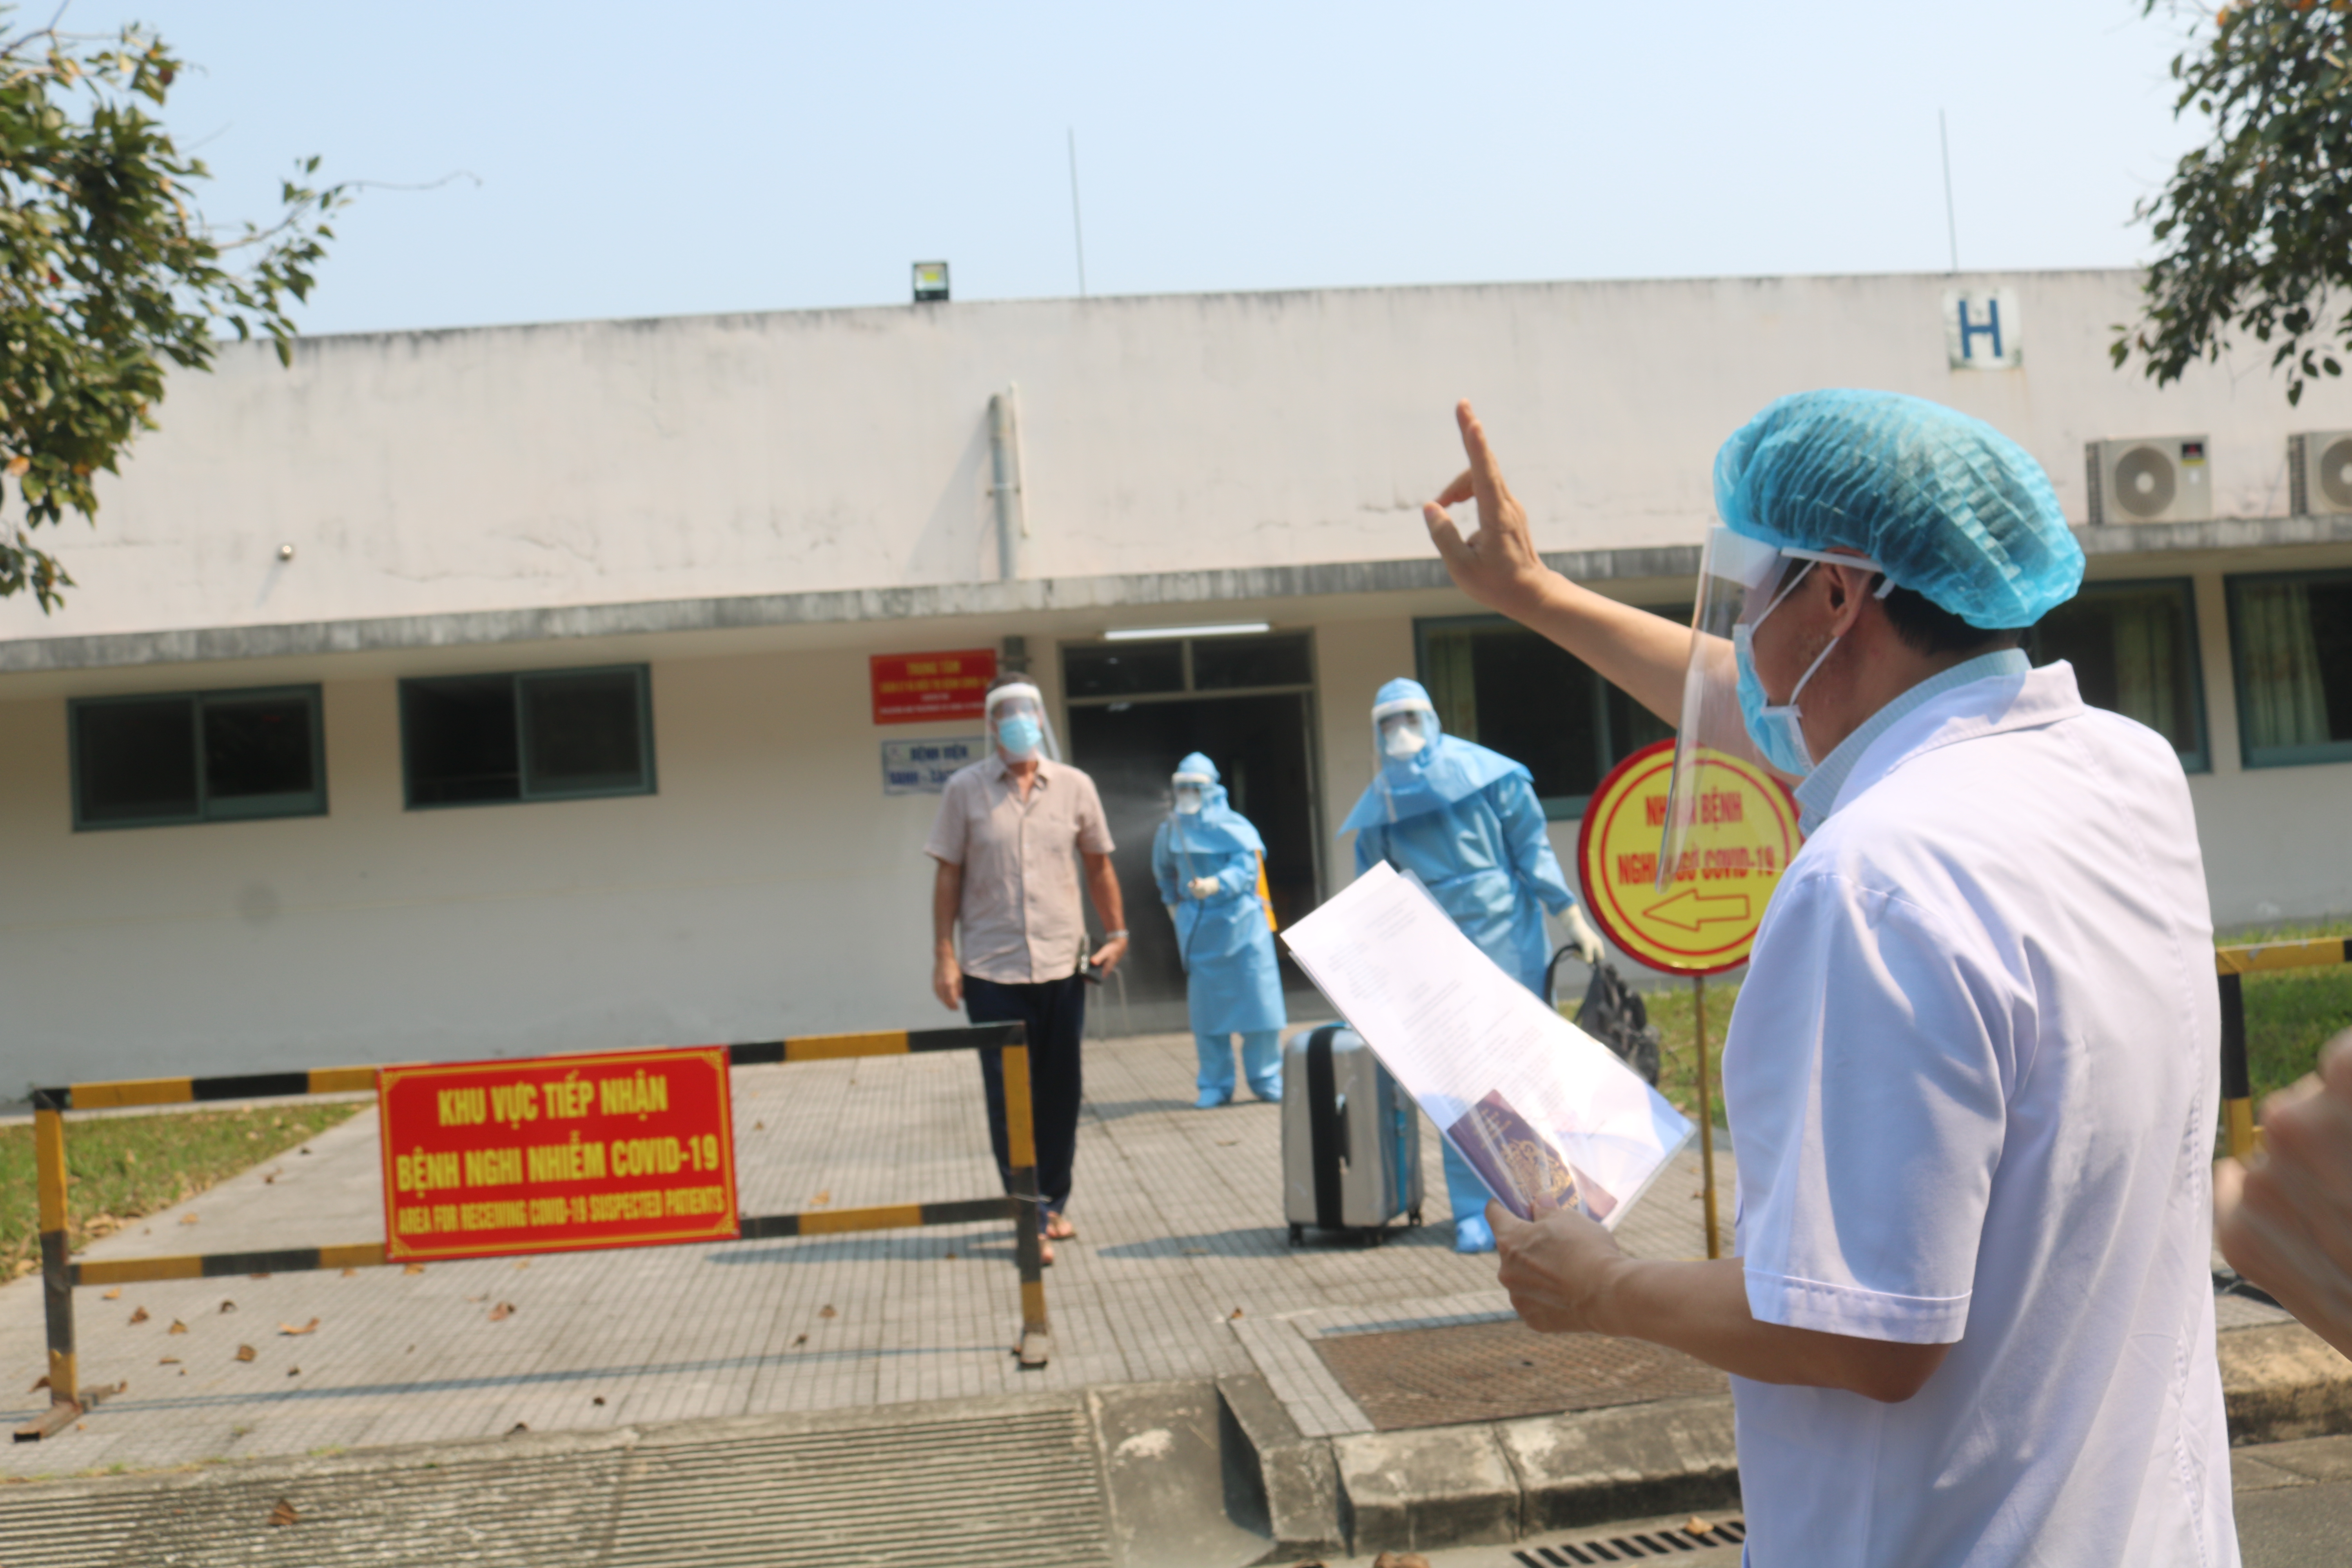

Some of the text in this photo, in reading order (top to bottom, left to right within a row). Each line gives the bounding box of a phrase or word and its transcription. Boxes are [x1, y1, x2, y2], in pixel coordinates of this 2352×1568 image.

[1958, 299, 2003, 358] H
[1646, 786, 1743, 831] NHN BỆNH
[1617, 852, 1657, 886] NGHI
[1702, 846, 1775, 879] COVID-19
[437, 1068, 669, 1130] KHU VỰC TIẾP NHẬN
[396, 1129, 719, 1199] BỆNH NGHI NHIỄM COVID-19
[398, 1184, 724, 1235] AREA FOR RECEIVING COVID-19 SUSPECTED PATIENTS
